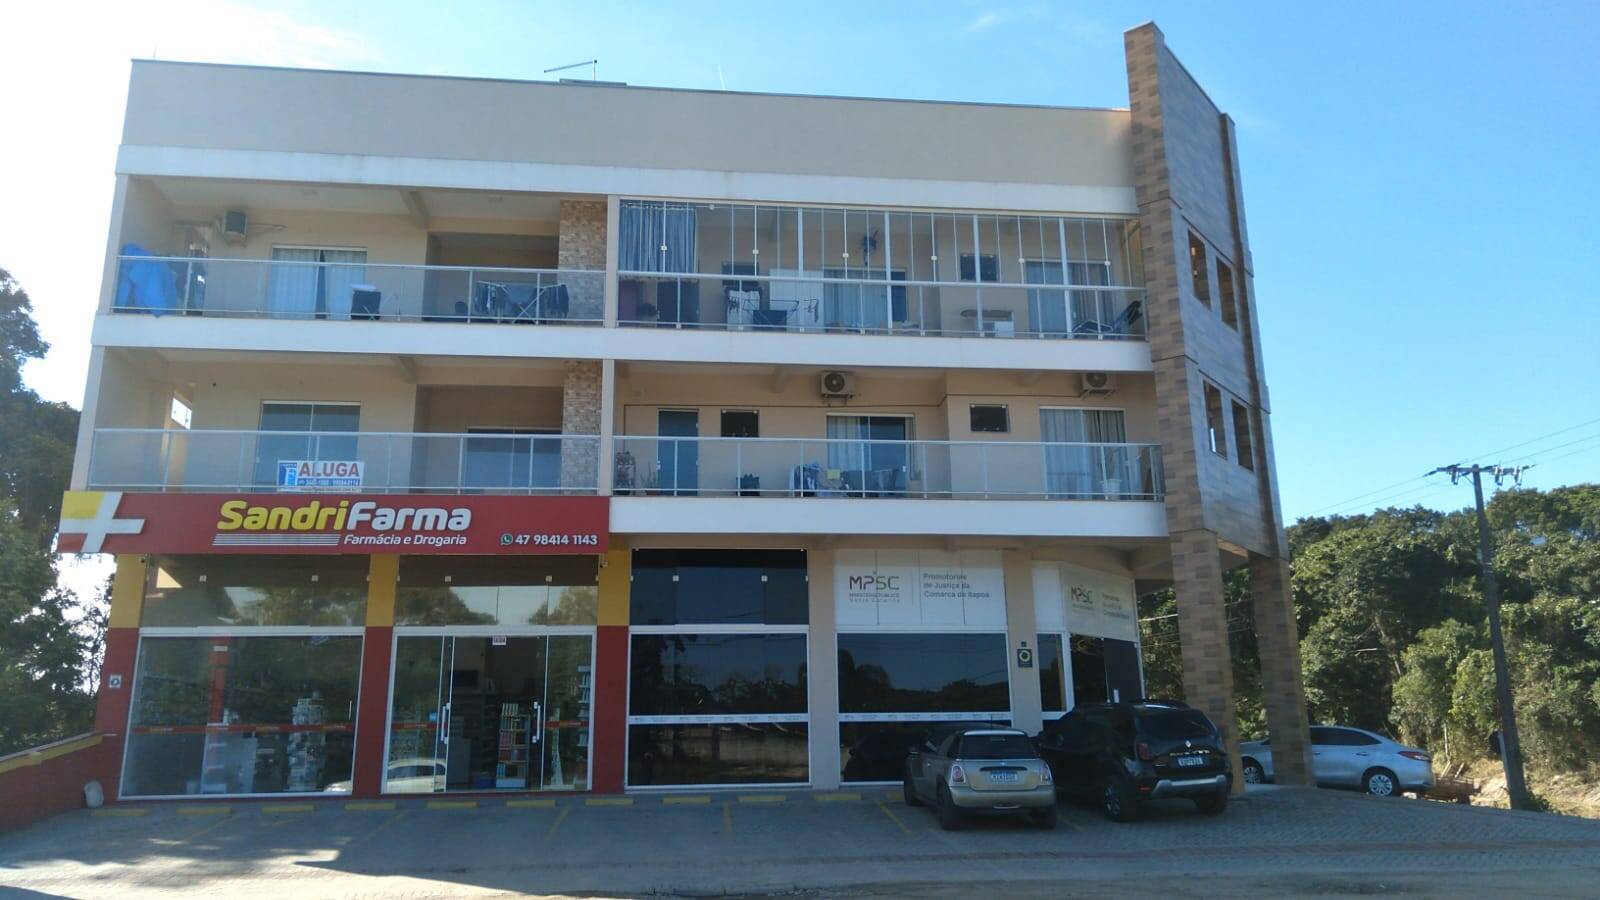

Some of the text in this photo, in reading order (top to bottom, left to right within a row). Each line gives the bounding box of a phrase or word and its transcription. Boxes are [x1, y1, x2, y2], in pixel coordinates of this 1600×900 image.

[299, 462, 360, 477] ALUGA
[216, 500, 472, 532] SandriFarma
[344, 534, 467, 547] Farmácia e Drogaria
[515, 534, 598, 545] 47 98414 1143
[849, 575, 900, 591] MPSC
[924, 590, 956, 598] Comarca
